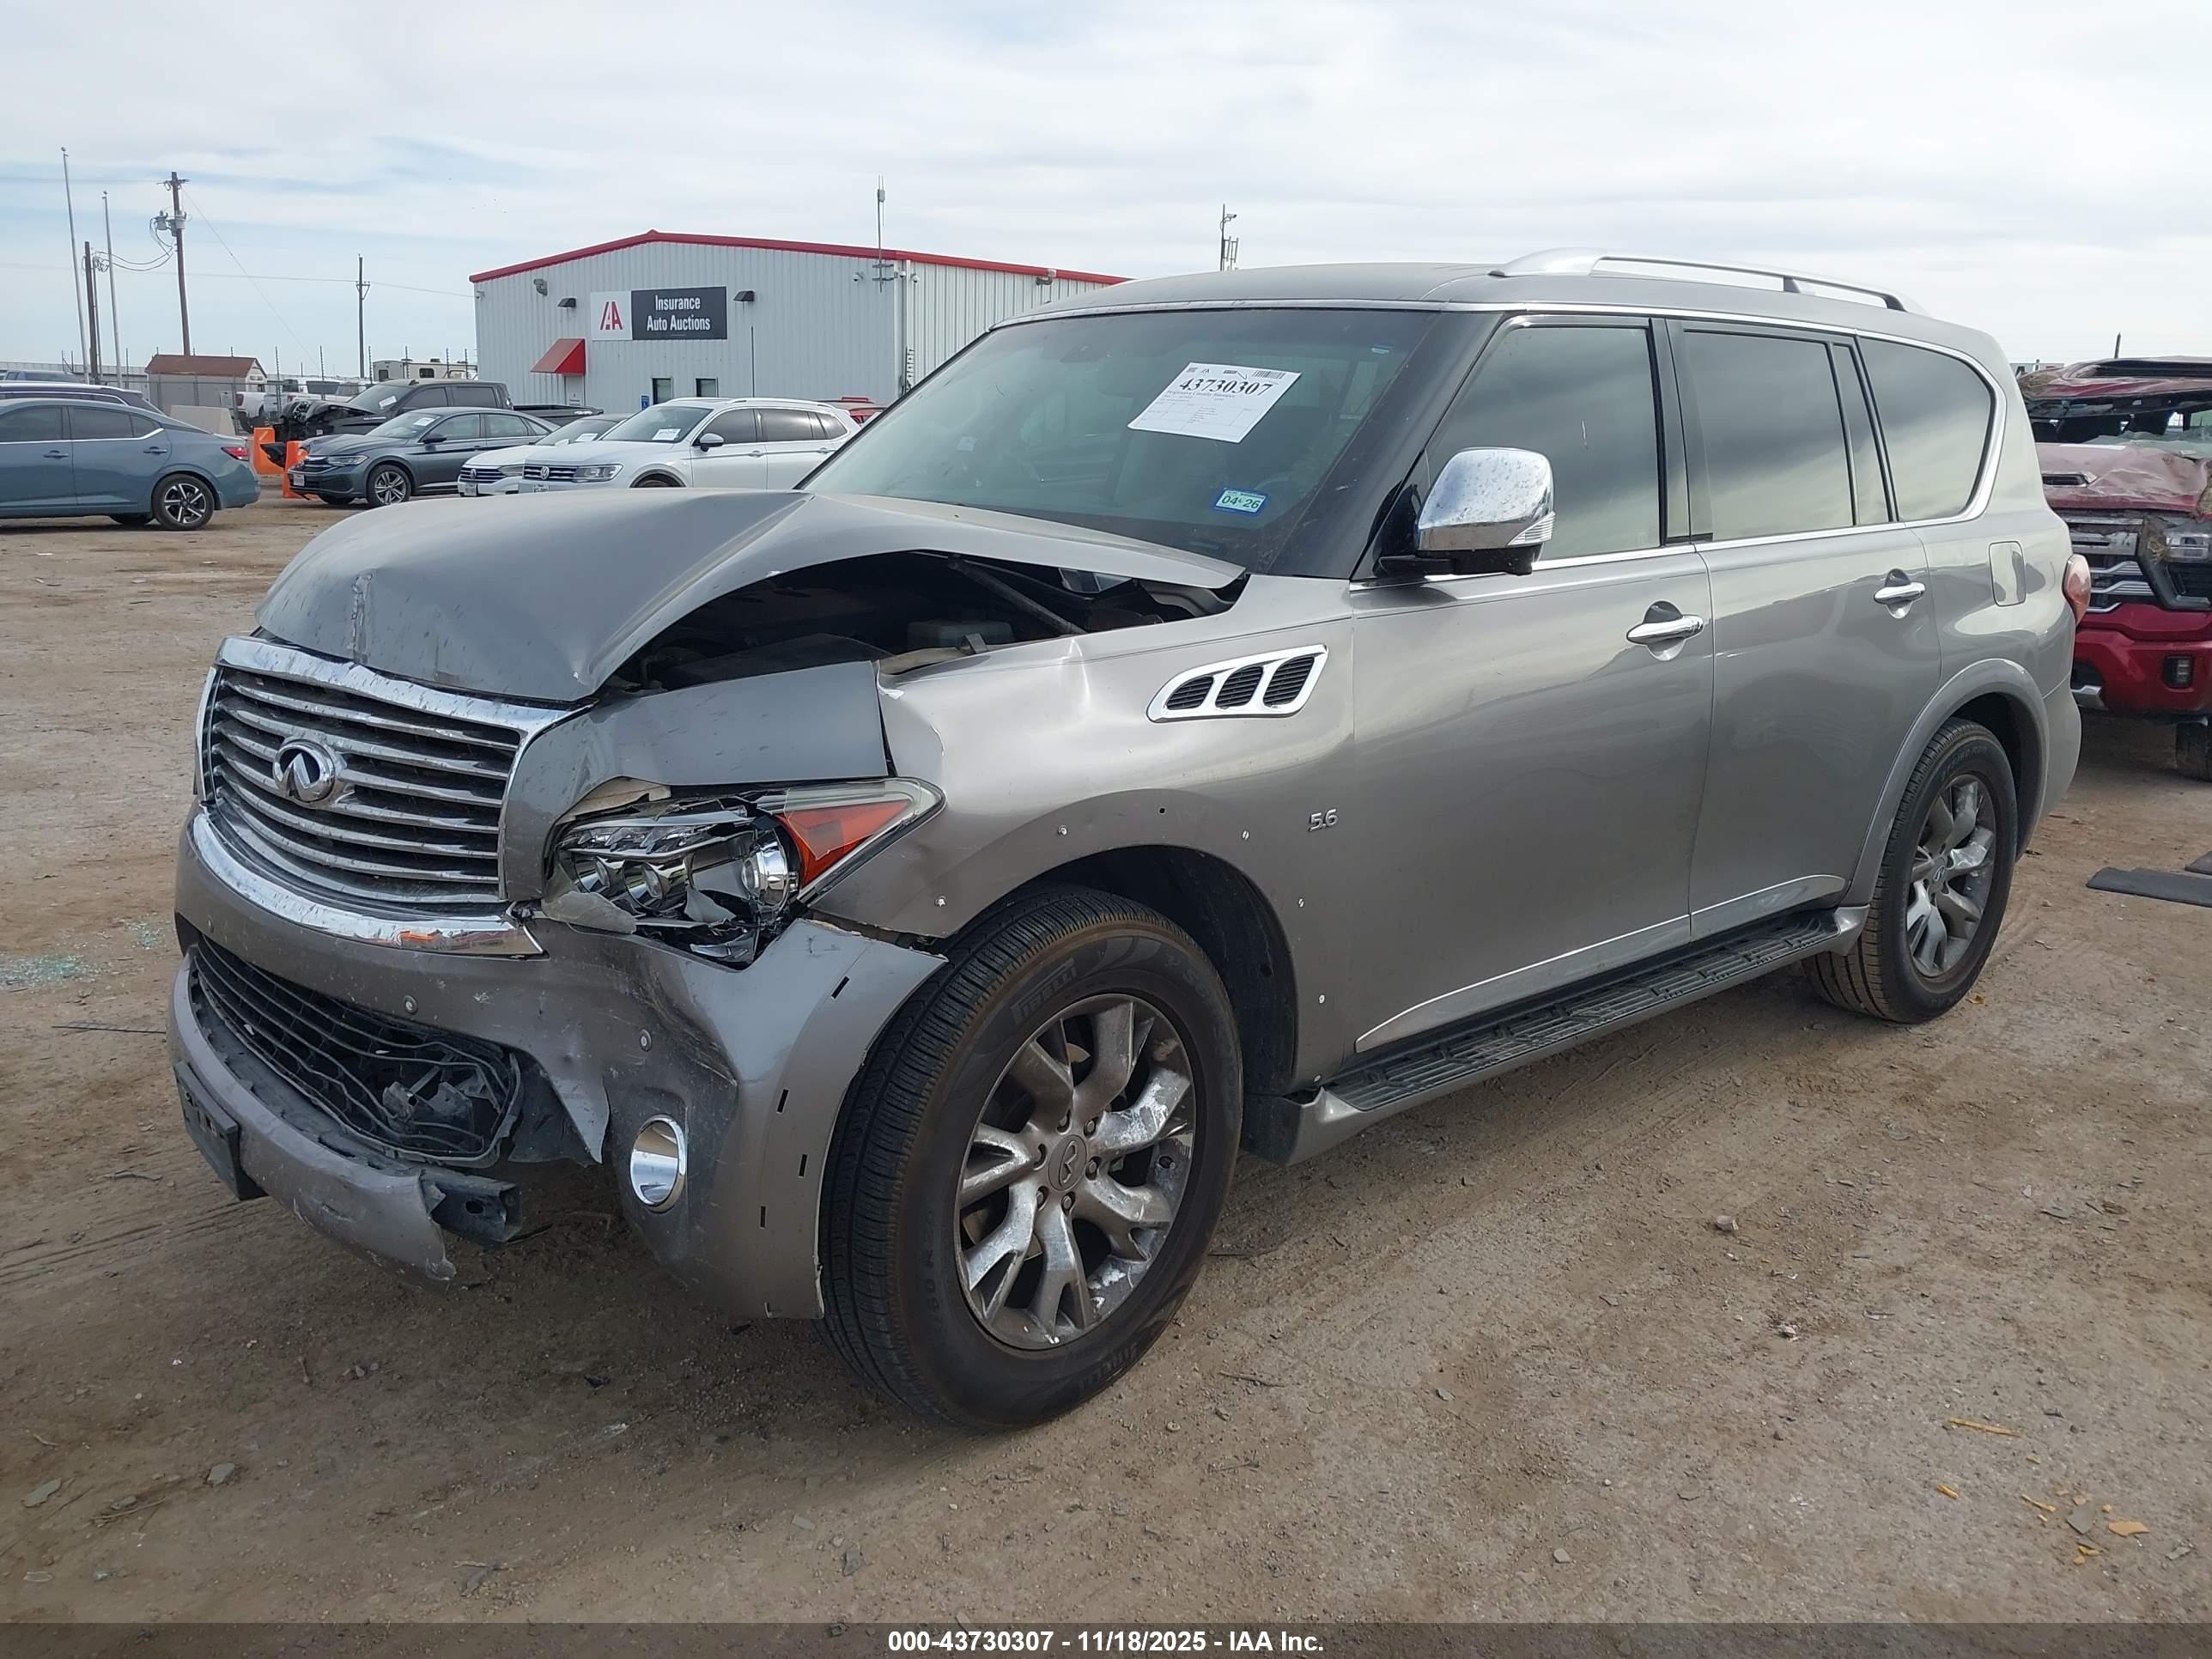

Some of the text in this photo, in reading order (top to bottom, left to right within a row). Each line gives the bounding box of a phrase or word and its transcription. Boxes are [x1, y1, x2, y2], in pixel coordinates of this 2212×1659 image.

[655, 295, 701, 311] Insurance
[647, 314, 711, 331] Auto Auctions
[1180, 378, 1273, 396] 43730307
[1308, 808, 1339, 832] 5.6
